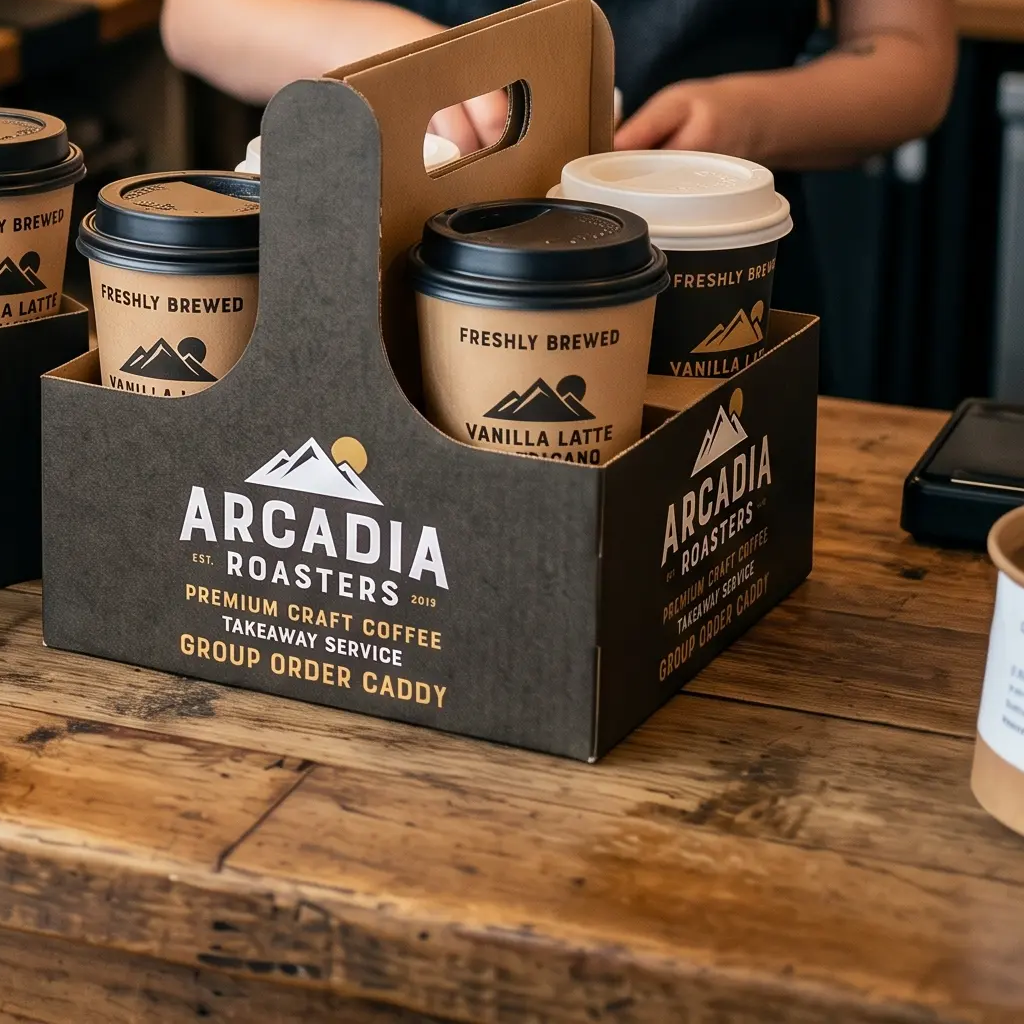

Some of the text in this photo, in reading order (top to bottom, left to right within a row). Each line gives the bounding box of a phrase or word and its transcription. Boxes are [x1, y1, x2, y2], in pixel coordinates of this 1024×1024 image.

[13, 208, 64, 232] BREWED
[19, 292, 58, 316] LATTE
[100, 283, 244, 314] FRESHLY BREWED
[674, 270, 744, 288] FRESHLY
[460, 326, 620, 351] FRESHLY BREWED
[670, 356, 740, 376] VANILLA
[466, 422, 613, 447] VANILLA LATTE
[660, 434, 772, 568] ARCADIA
[178, 485, 450, 590] ARCADIA
[681, 500, 753, 576] ROASTERS
[192, 550, 436, 608] EST. ROASTERS 2019
[662, 526, 768, 626] PREMIUM CRAFT COFFEE
[677, 559, 755, 635] TAKEAWAY SERVICE
[185, 583, 442, 650] PREMIUM CRAFT COFFEE
[222, 615, 403, 667] TAKEAWAY SERVICE
[658, 571, 770, 682] GROUP ORDER CADDY
[180, 633, 446, 708] GROUP ORDER CADDY
